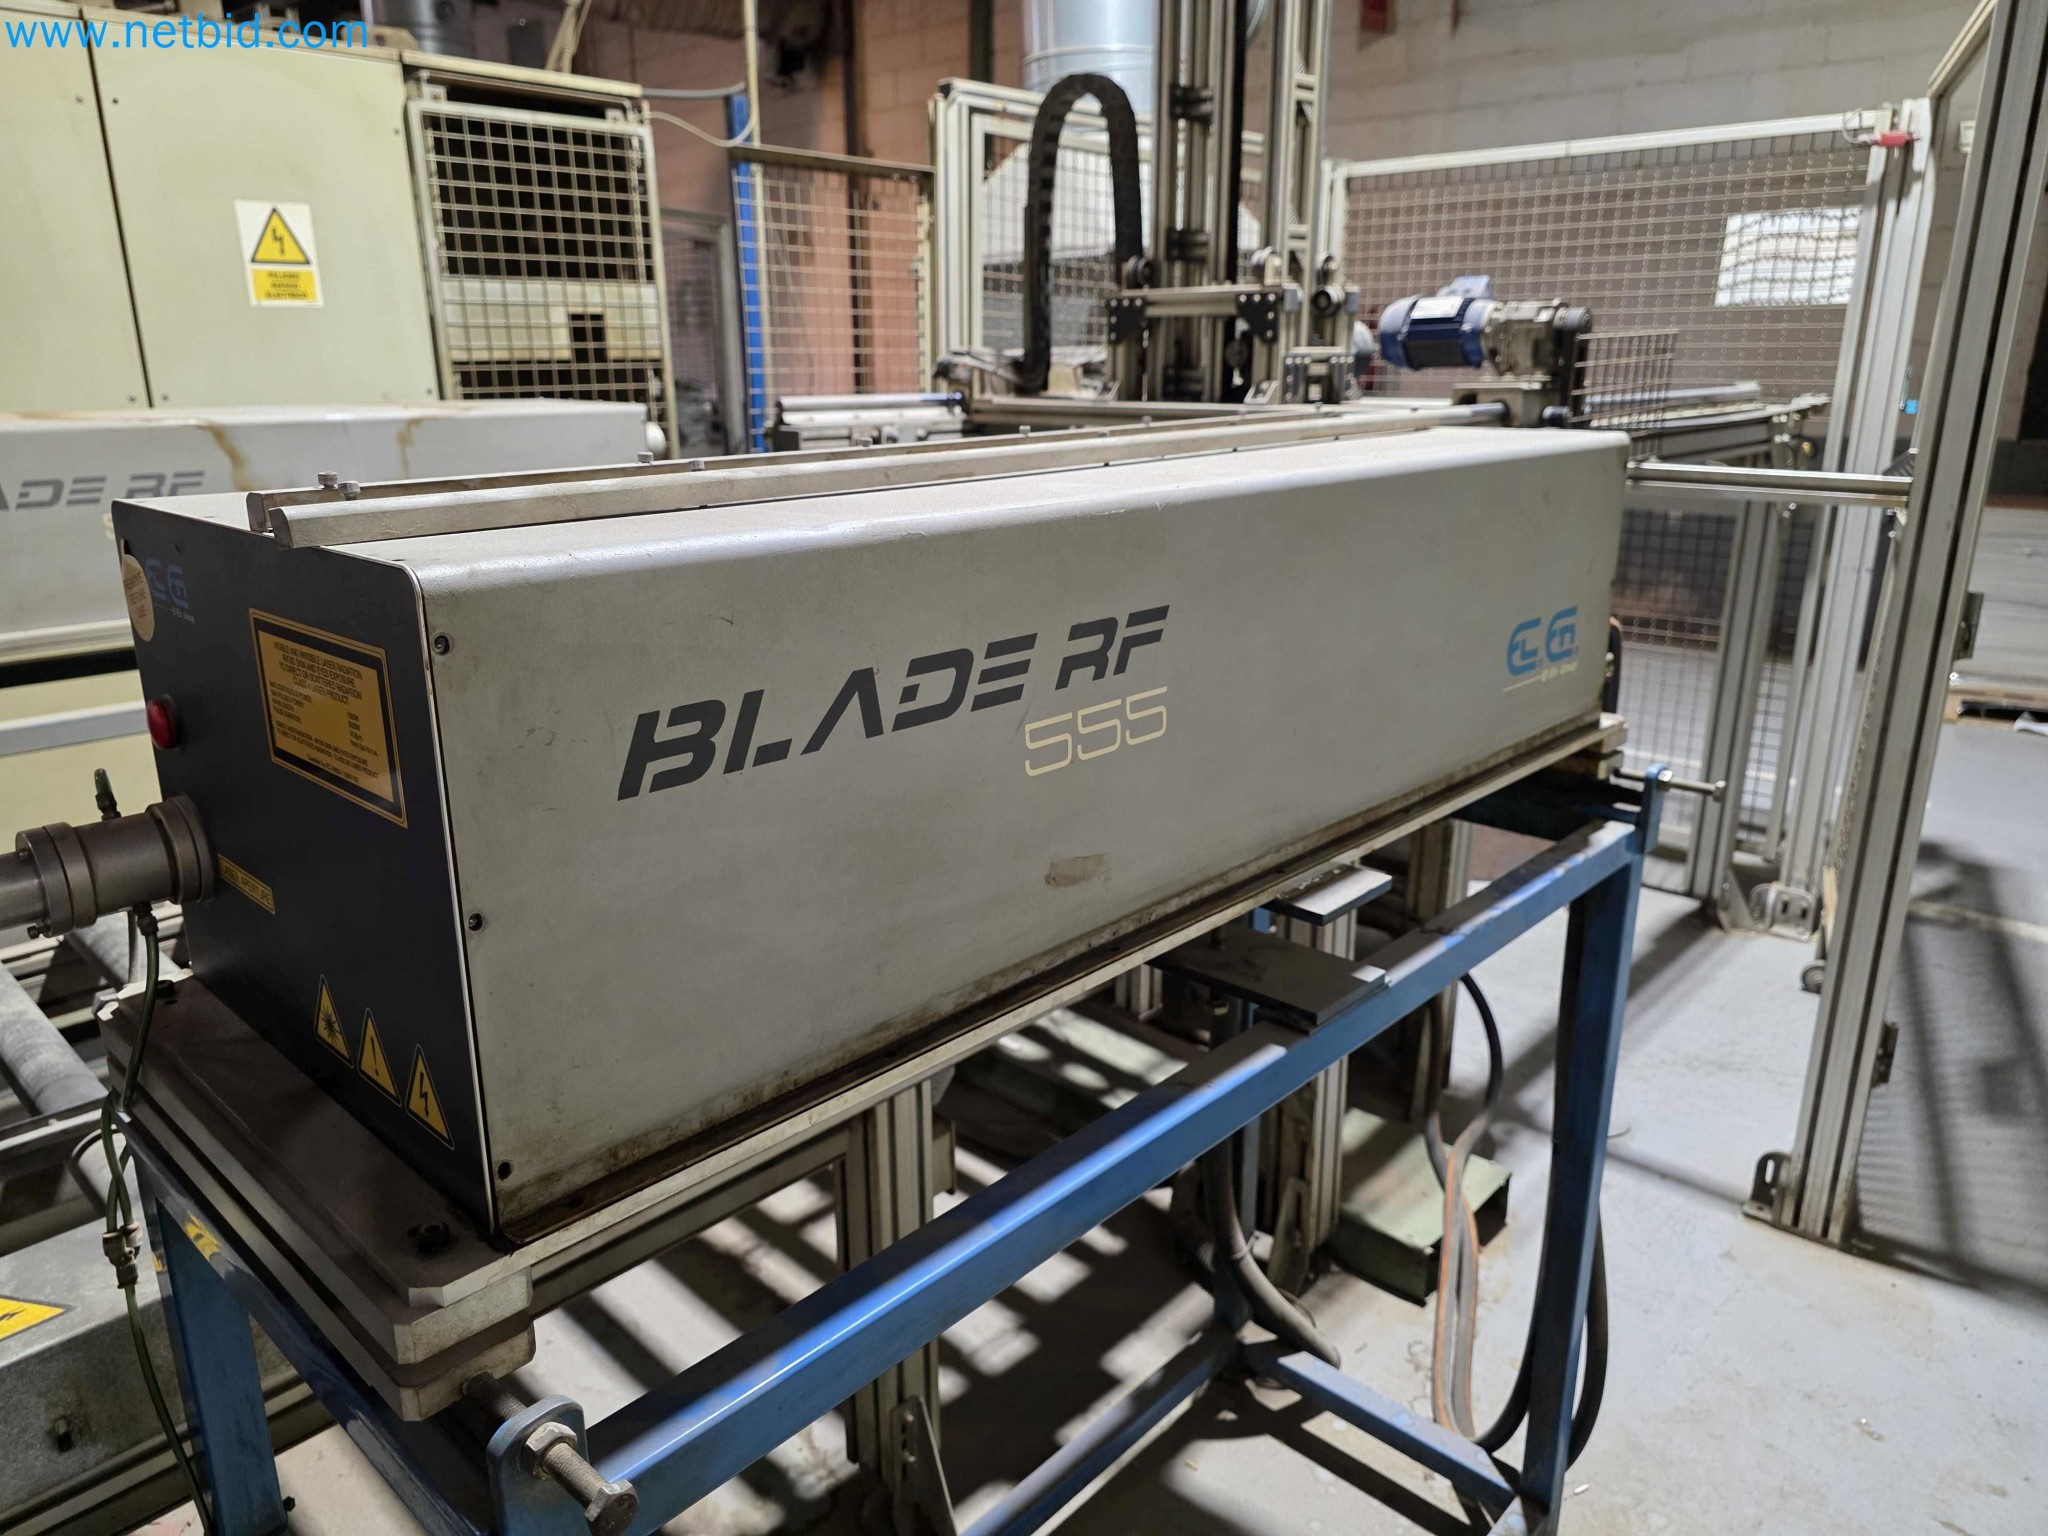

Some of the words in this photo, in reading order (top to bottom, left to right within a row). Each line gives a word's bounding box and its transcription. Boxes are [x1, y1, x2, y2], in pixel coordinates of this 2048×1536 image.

[311, 683, 326, 696] LASER
[326, 688, 349, 706] PRODUCT
[320, 657, 336, 671] LASER
[336, 662, 362, 680] RADIATION
[617, 632, 1038, 801] BLADE
[1055, 604, 1170, 691] RF
[1025, 685, 1168, 777] 555
